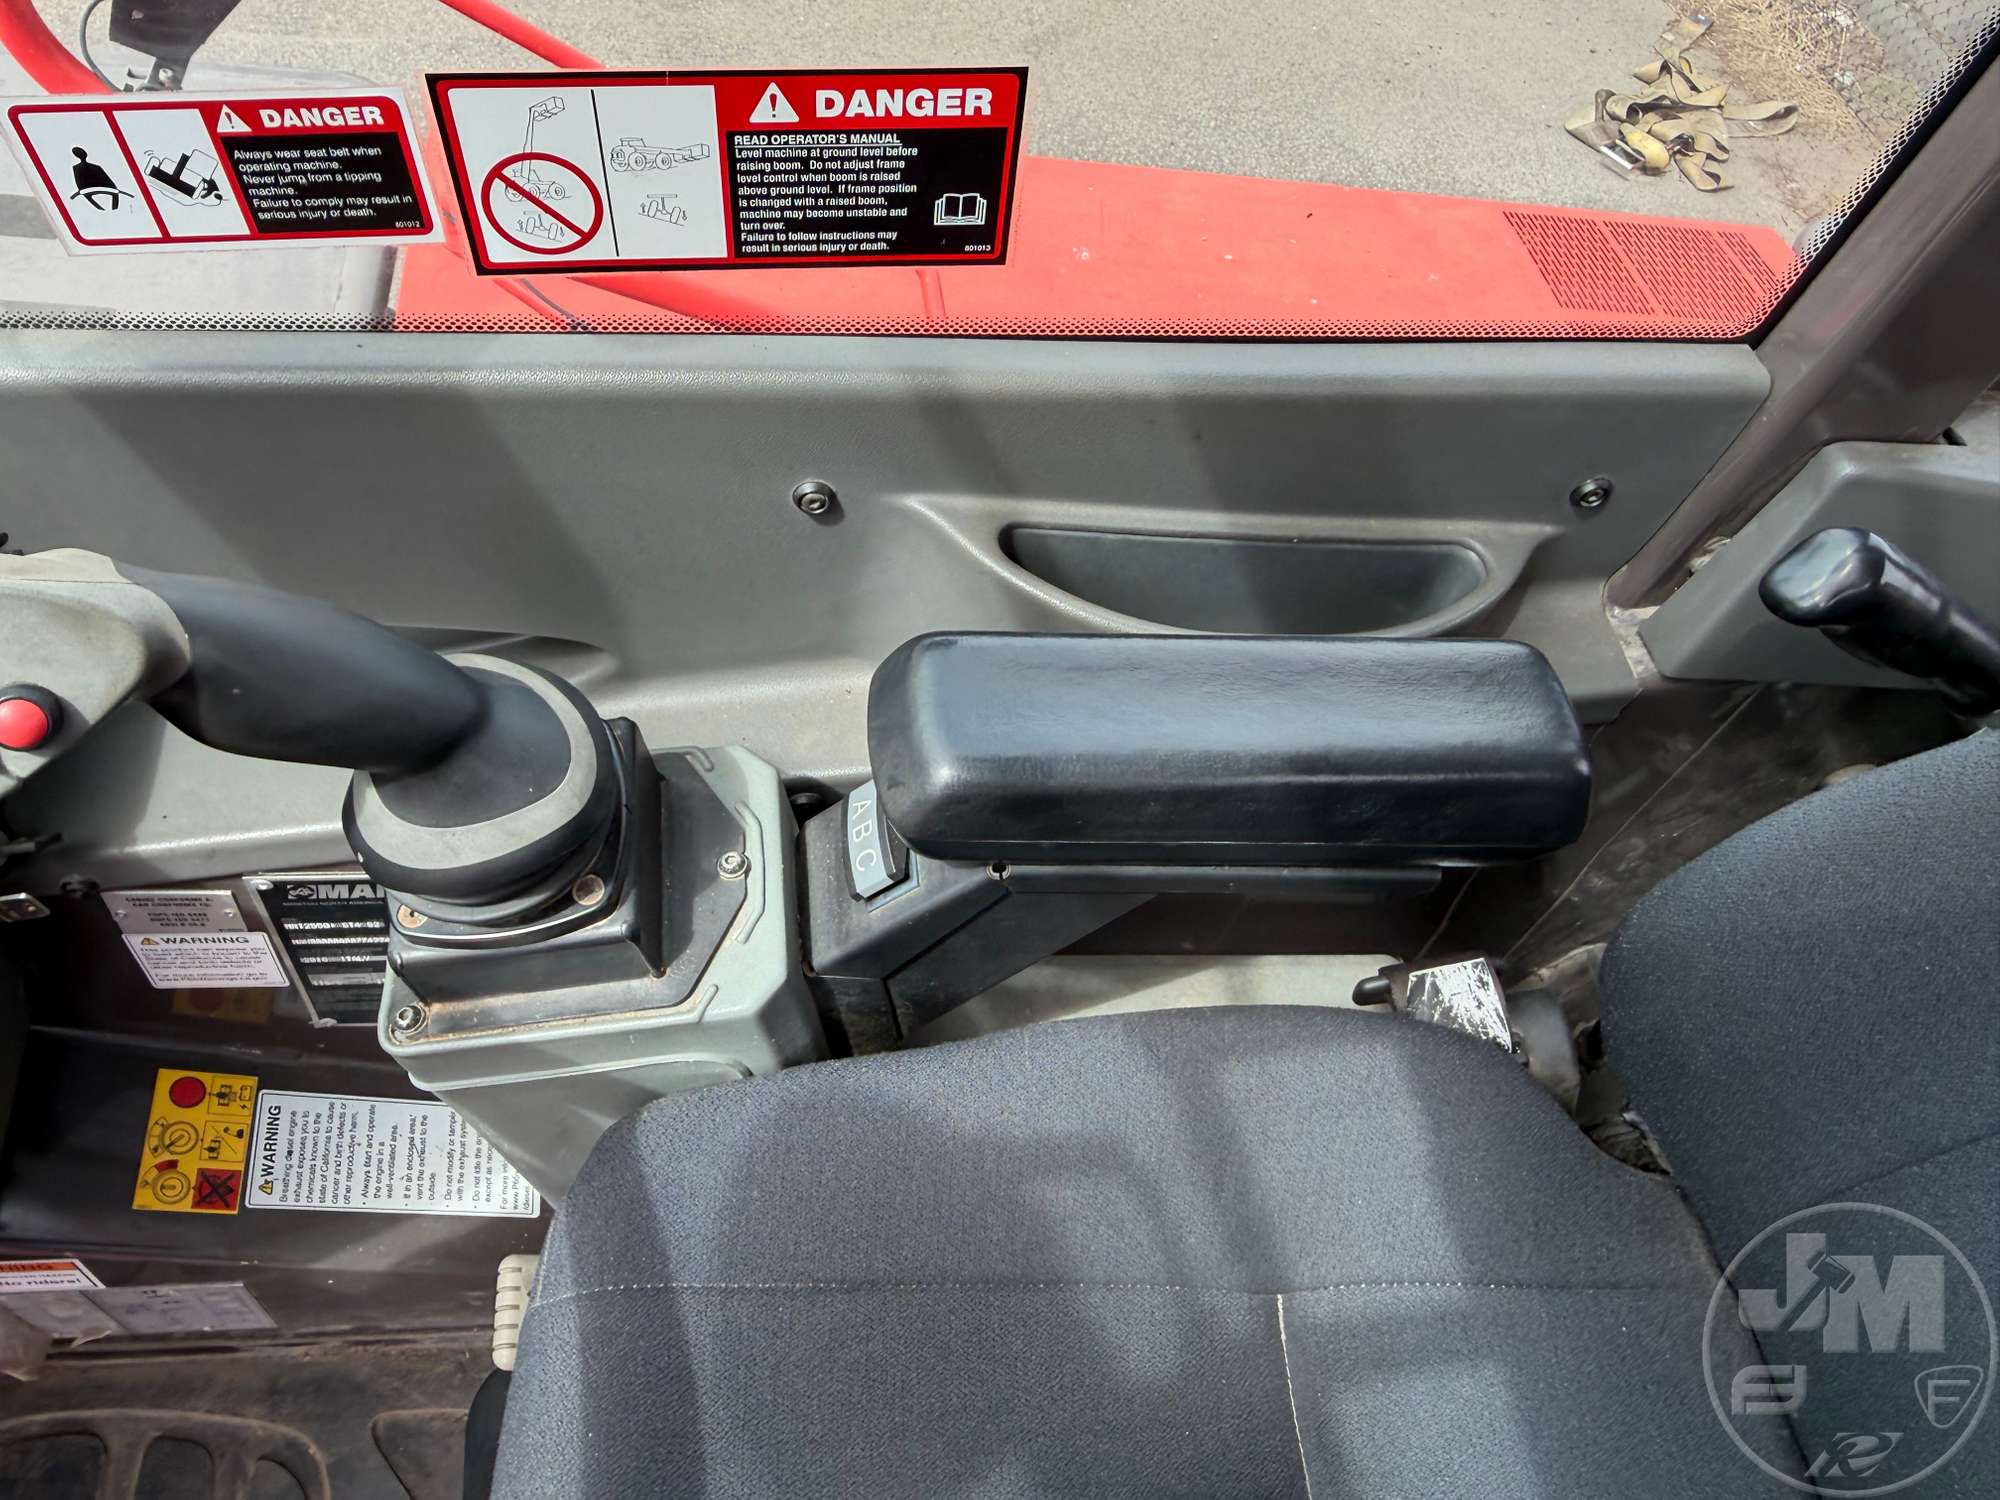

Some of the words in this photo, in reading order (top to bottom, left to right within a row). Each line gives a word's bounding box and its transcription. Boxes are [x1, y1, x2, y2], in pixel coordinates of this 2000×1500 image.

[815, 88, 992, 118] DANGER
[259, 106, 384, 128] DANGER
[735, 135, 768, 145] READ
[771, 134, 848, 145] OPERATOR'S
[851, 133, 900, 144] MANUAL
[234, 150, 272, 161] Always
[276, 150, 301, 159] wear
[304, 149, 326, 158] seat
[329, 148, 350, 157] belt
[352, 147, 382, 156] when
[736, 149, 763, 159] Level
[765, 148, 807, 158] machine
[811, 148, 821, 157] at
[823, 147, 858, 159] ground
[860, 147, 884, 157] level
[886, 147, 918, 156] before
[239, 162, 291, 173] operating
[294, 161, 343, 170] machine.
[737, 161, 771, 172] raising
[773, 160, 804, 170] boom.
[810, 160, 823, 169] Do
[825, 160, 841, 169] not
[844, 160, 874, 170] adjust
[877, 159, 905, 169] frame
[243, 175, 275, 184] Never
[278, 174, 306, 185] jump
[308, 173, 333, 183] from
[345, 172, 382, 183] tipping
[738, 173, 761, 183] level
[764, 173, 798, 182] control
[801, 172, 827, 182] when
[830, 172, 857, 182] boom
[859, 172, 868, 181] is
[870, 171, 900, 181] raised
[249, 186, 298, 196] machine.
[739, 185, 768, 195] above
[770, 185, 804, 196] ground
[807, 185, 833, 194] level.
[839, 184, 846, 194] If
[848, 184, 876, 194] frame
[879, 183, 917, 194] position
[253, 198, 289, 208] Failure
[291, 197, 302, 207] to
[305, 197, 344, 208] comply
[346, 197, 369, 207] may
[372, 196, 401, 205] result
[403, 195, 412, 203] in
[739, 198, 748, 207] is
[750, 197, 792, 209] changed
[794, 196, 815, 206] with
[818, 198, 824, 206] a
[826, 196, 856, 206] raised
[858, 196, 888, 206] boom,
[258, 209, 297, 220] serious
[299, 209, 327, 220] injury
[330, 210, 341, 218] or
[344, 207, 376, 217] death.
[740, 209, 781, 219] machine
[784, 211, 804, 220] may
[807, 209, 843, 218] become
[847, 208, 887, 217] unstable
[890, 208, 908, 217] and
[741, 222, 760, 230] turn
[763, 222, 786, 230] over.
[742, 232, 774, 242] Failure
[777, 232, 786, 241] to
[788, 232, 817, 241] follow
[820, 231, 875, 240] instructions
[878, 232, 898, 240] may
[742, 243, 769, 253] result
[772, 243, 780, 252] in
[783, 243, 817, 252] serious
[820, 242, 846, 253] injury
[848, 243, 858, 251] or
[861, 241, 889, 250] death.
[161, 937, 250, 945] WARNING
[260, 1105, 281, 1177] WARNING
[361, 1170, 372, 1198] Always
